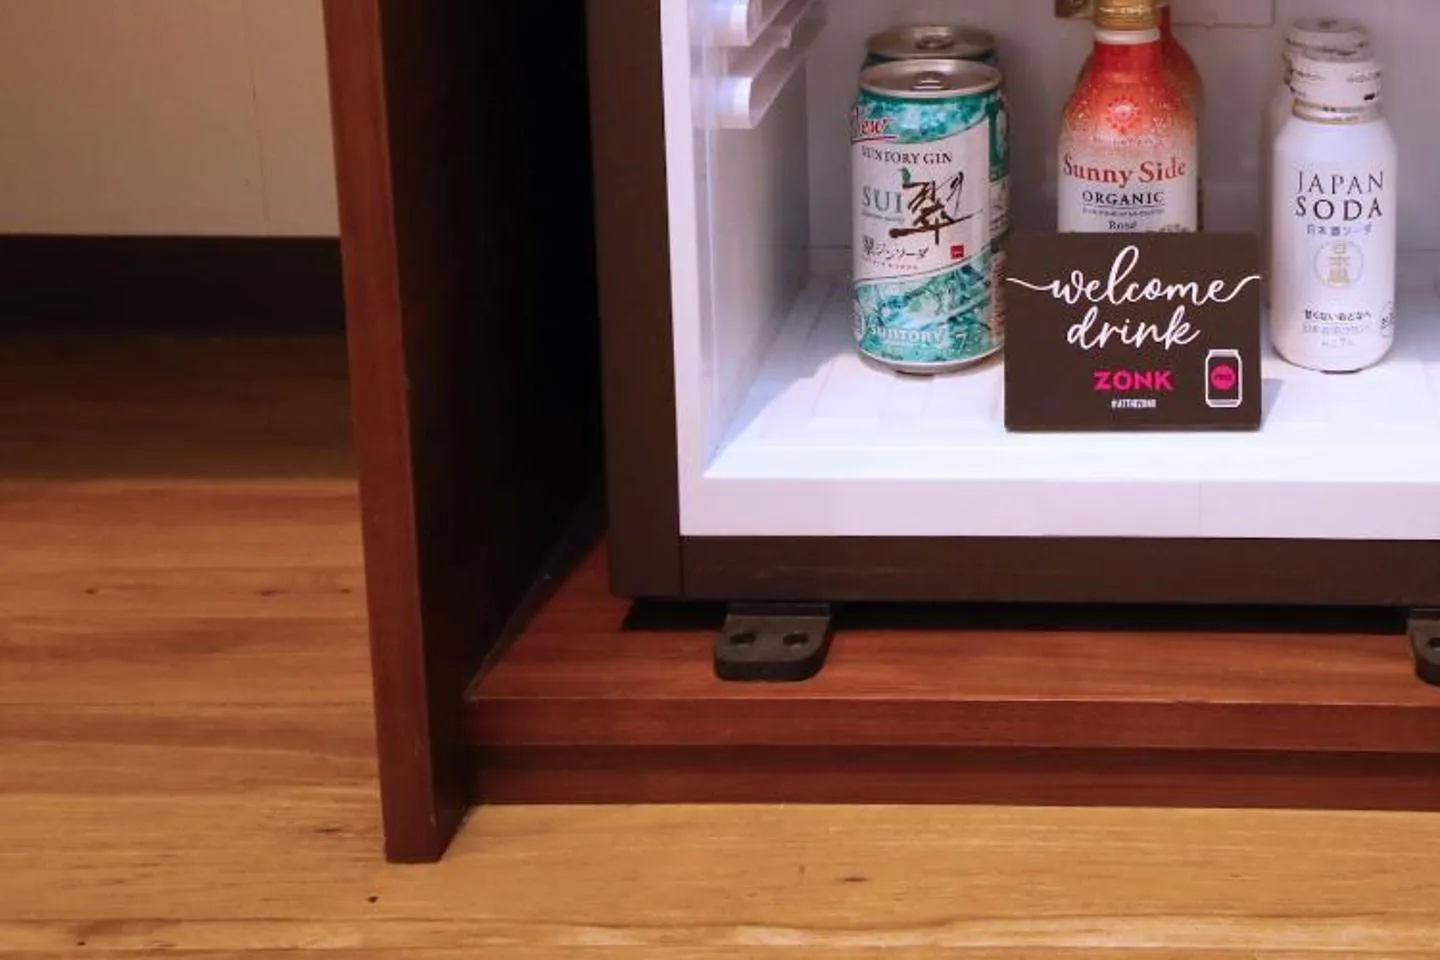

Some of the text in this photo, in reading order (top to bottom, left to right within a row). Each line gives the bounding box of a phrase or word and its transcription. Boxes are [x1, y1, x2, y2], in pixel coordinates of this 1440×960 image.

[923, 151, 953, 164] GIN
[1063, 153, 1187, 188] Sunny Side
[1297, 170, 1384, 195] JAPAN
[1083, 191, 1165, 206] ORGANIC
[1295, 196, 1384, 221] SODA
[1006, 245, 1262, 305] welcome
[1066, 304, 1201, 351] drink
[1093, 370, 1174, 390] ZONK
